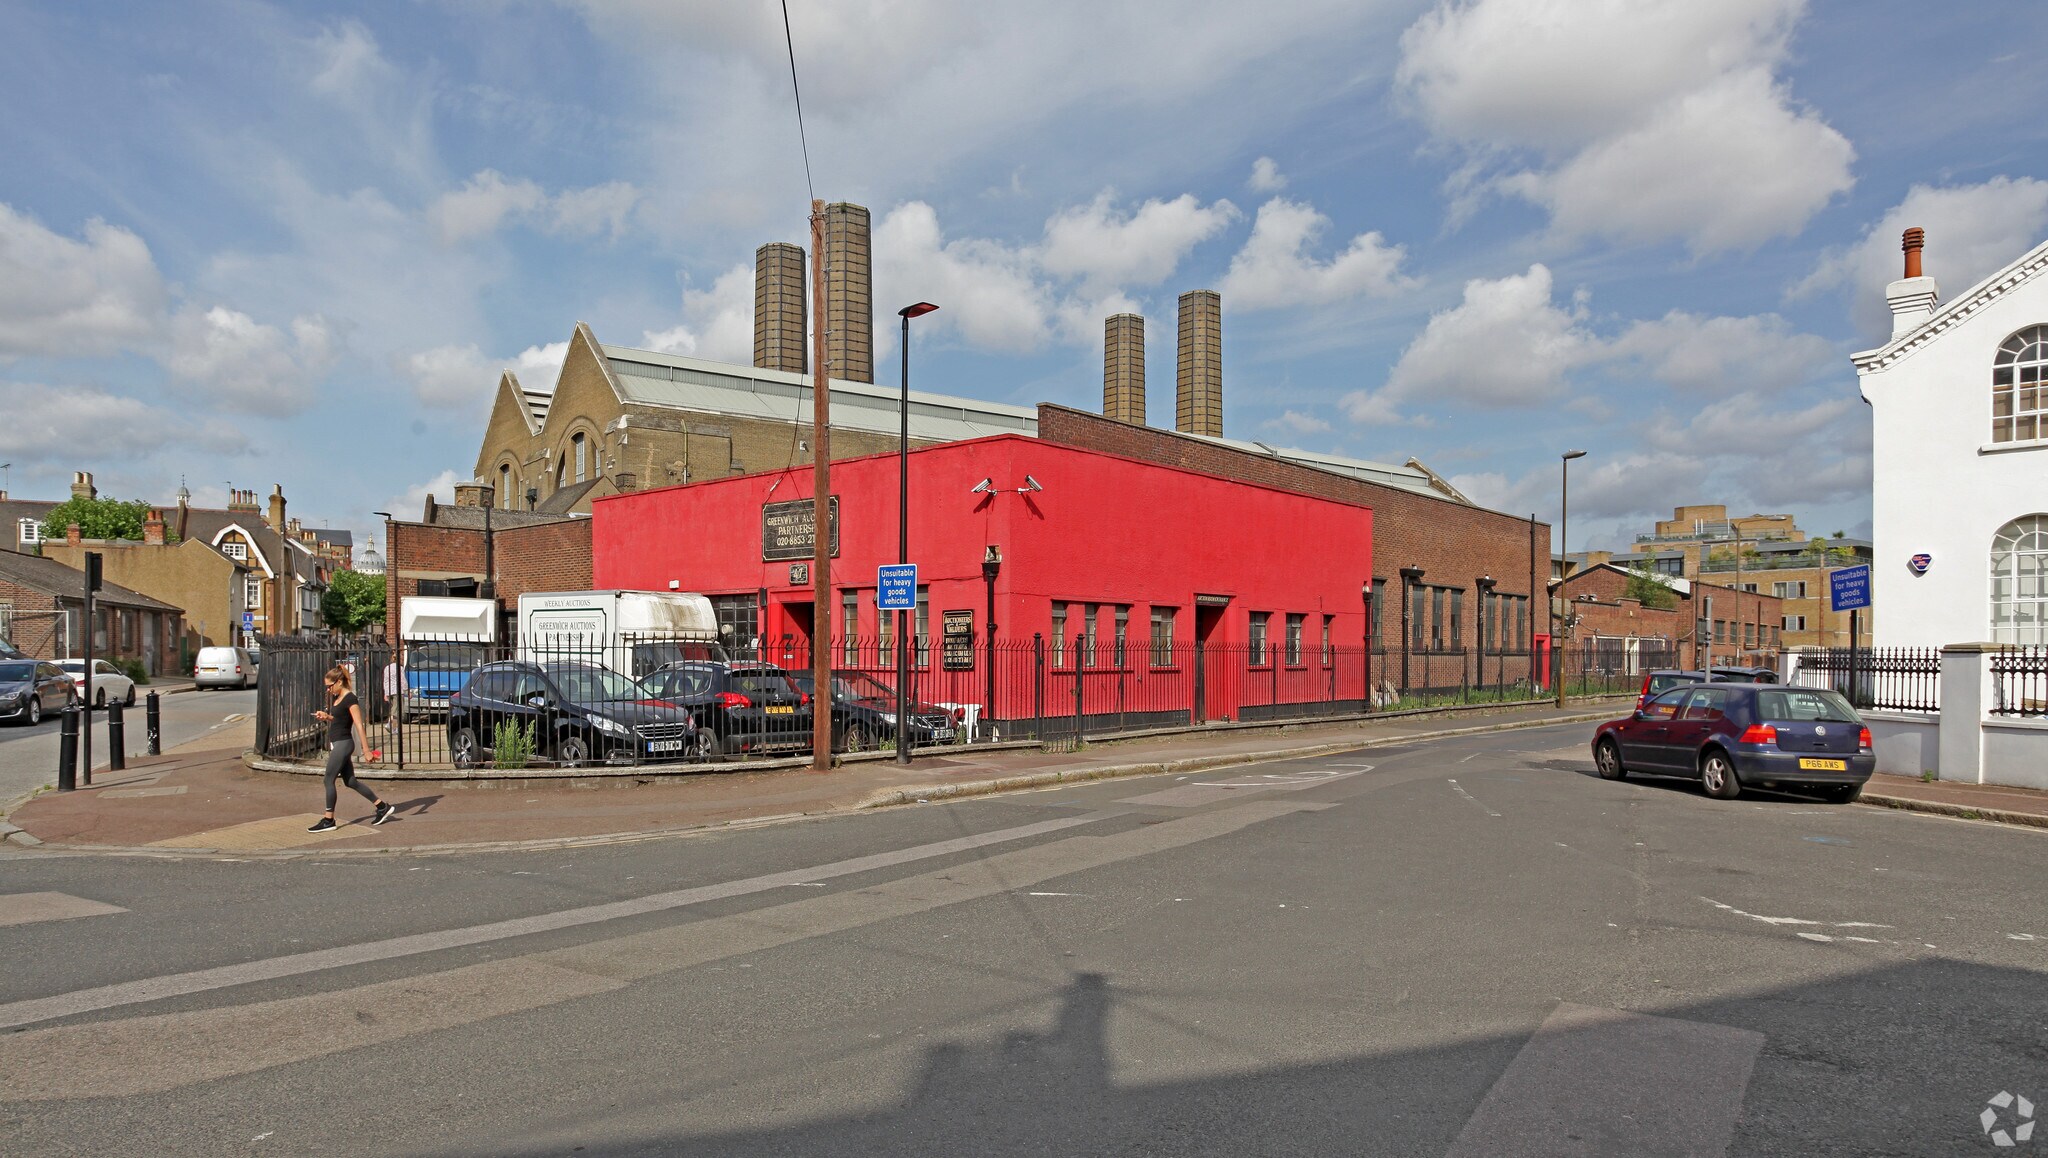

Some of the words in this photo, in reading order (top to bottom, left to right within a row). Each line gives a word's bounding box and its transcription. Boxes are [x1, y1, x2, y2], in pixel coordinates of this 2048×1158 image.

[767, 514, 799, 526] GREENWICH
[881, 569, 914, 578] Unsuitable
[1832, 569, 1867, 582] Unsuitable
[883, 578, 893, 587] for
[893, 578, 912, 588] heavy
[1835, 582, 1845, 591] for
[1845, 579, 1865, 589] heavy
[887, 587, 907, 597] goods
[1840, 588, 1860, 600] goods
[544, 599, 564, 608] WEEKLY
[566, 599, 591, 608] AUCTIONS
[884, 596, 909, 605] vehicles
[1837, 596, 1864, 608] vehicles
[539, 620, 569, 631] GREENWICH
[569, 620, 596, 631] AUCTIONS
[1805, 759, 1823, 768] P66
[1824, 760, 1840, 769] AWS
